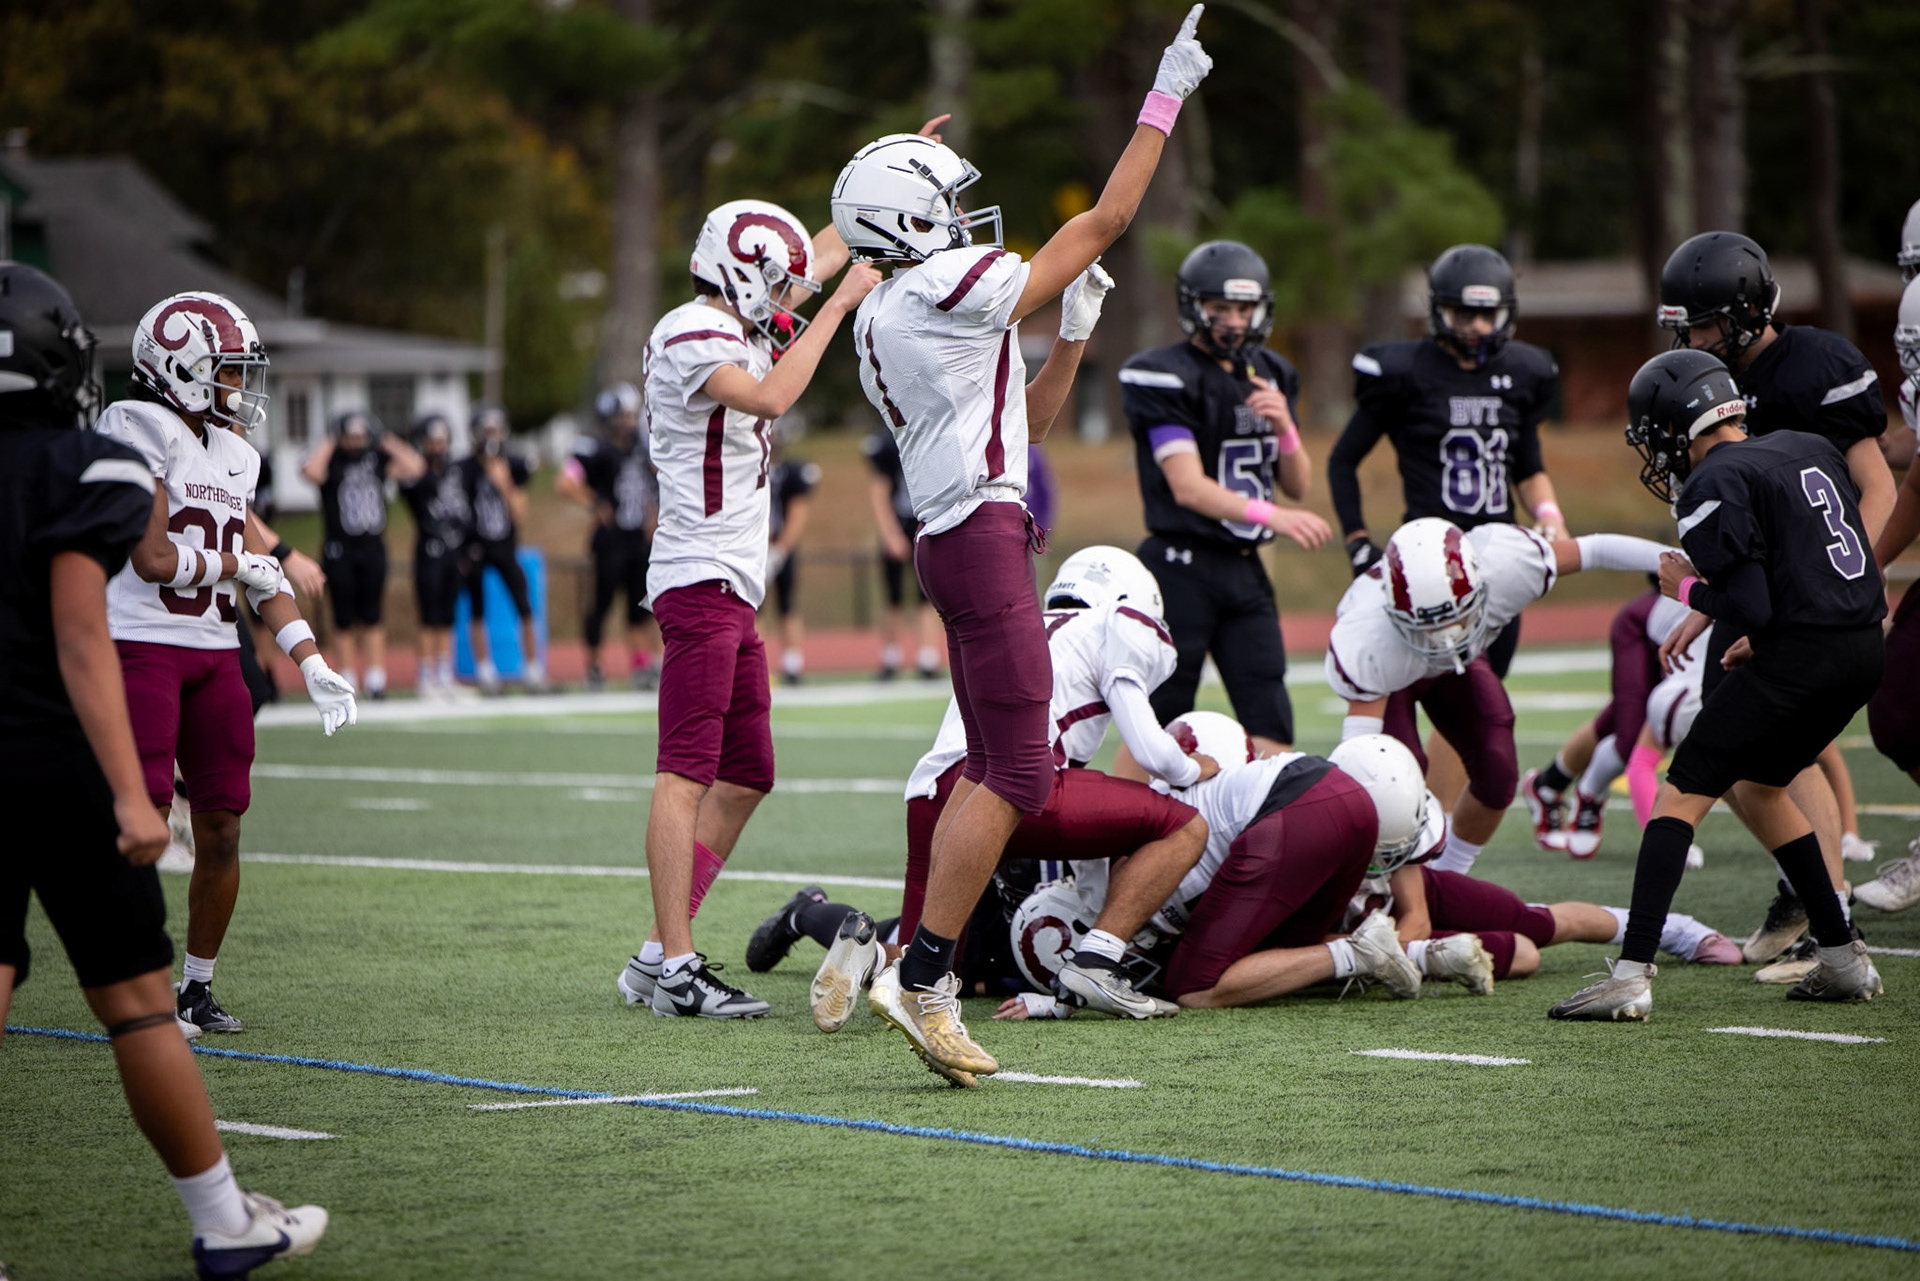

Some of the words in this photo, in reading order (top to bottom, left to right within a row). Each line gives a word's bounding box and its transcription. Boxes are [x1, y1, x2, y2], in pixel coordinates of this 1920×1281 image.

[1449, 397, 1502, 426] BVT
[1440, 428, 1509, 514] 81
[1800, 466, 1866, 580] 3
